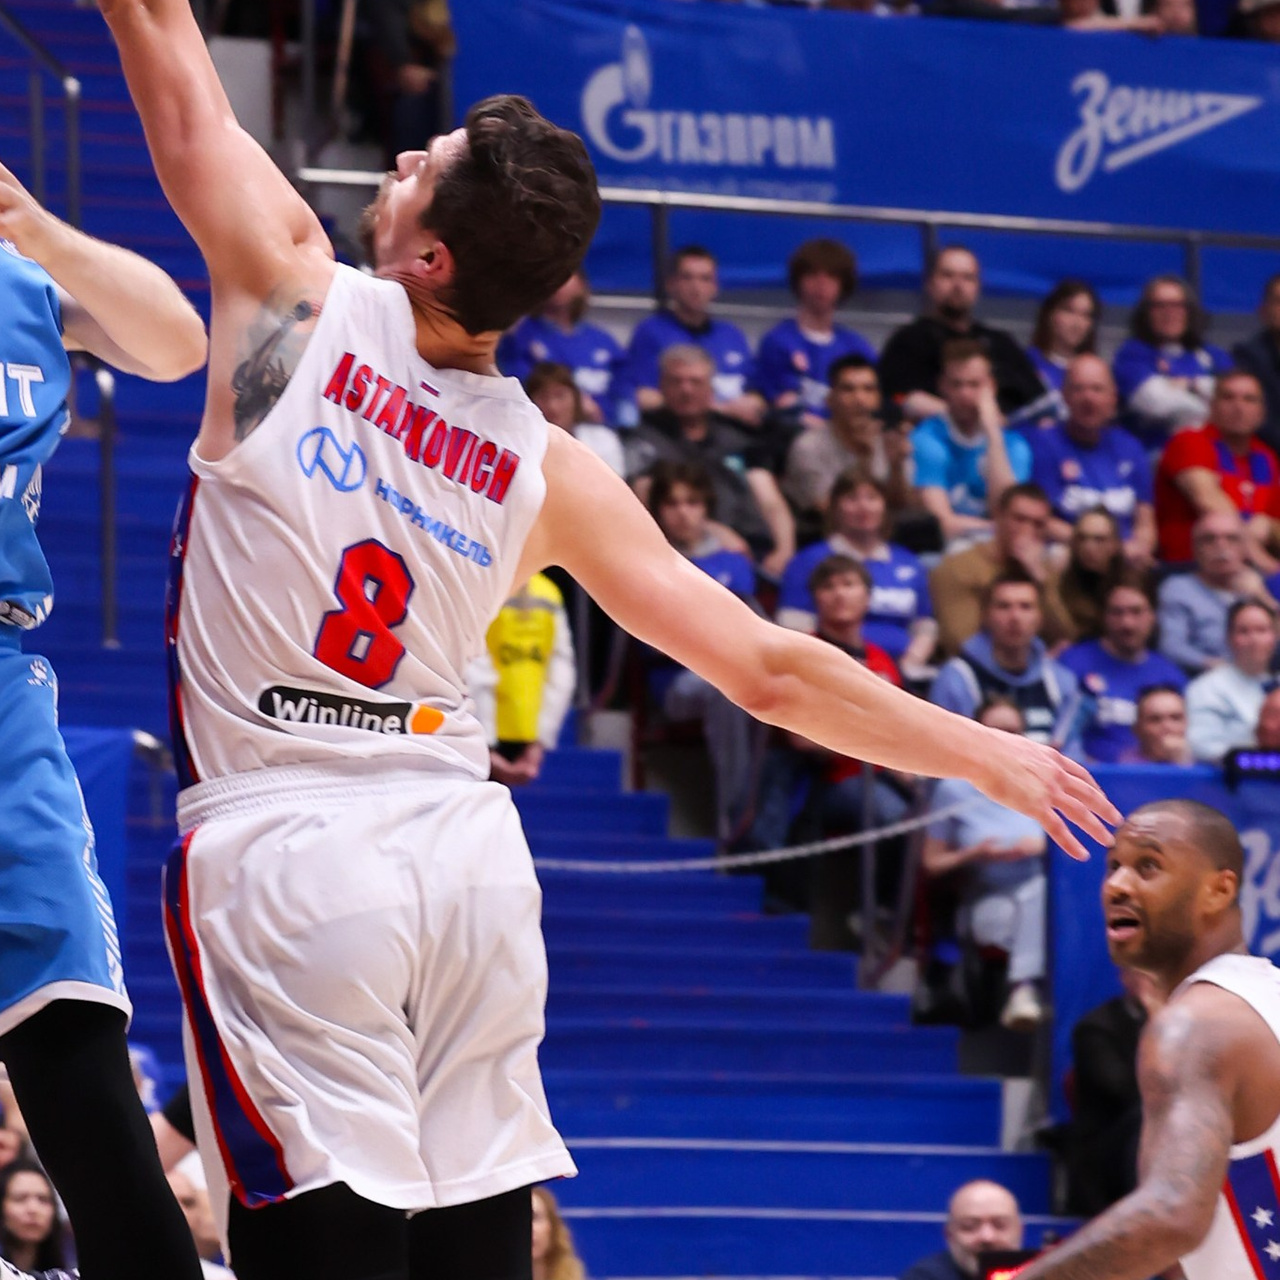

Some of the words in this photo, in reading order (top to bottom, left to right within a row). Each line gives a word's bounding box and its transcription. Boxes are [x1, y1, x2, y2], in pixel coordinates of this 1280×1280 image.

[660, 111, 836, 168] ГАЗПРОМ
[1055, 70, 1264, 193] Зенит
[312, 537, 416, 691] 8
[271, 691, 402, 736] Winline
